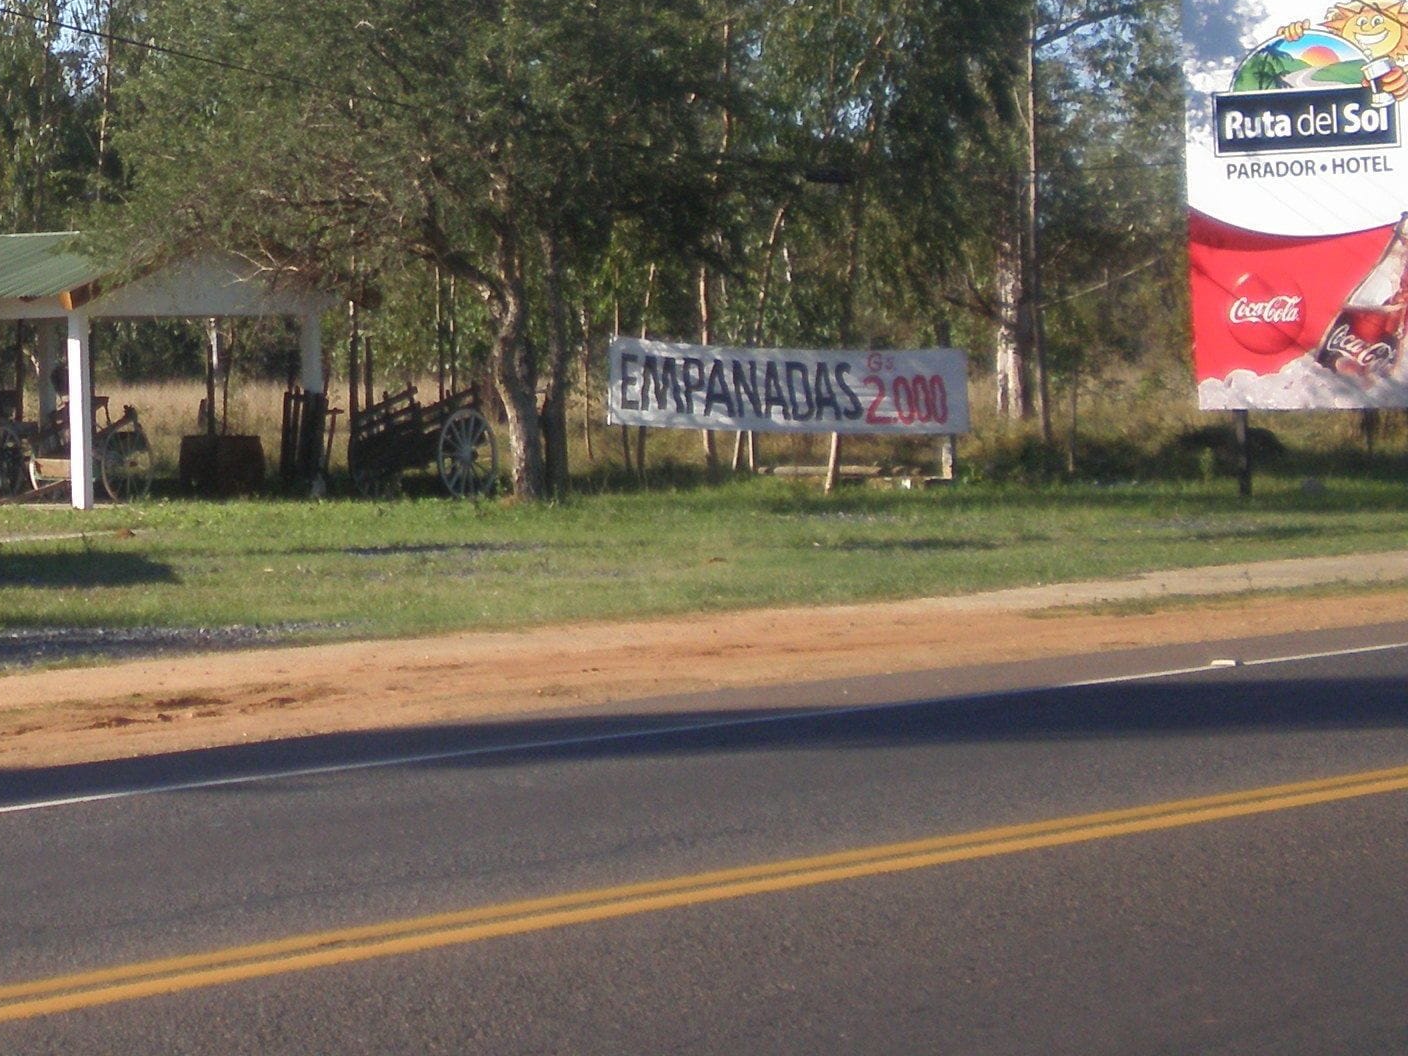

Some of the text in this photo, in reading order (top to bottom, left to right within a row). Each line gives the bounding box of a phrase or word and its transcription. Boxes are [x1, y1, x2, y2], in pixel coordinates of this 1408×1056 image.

[1225, 102, 1389, 140] Ruta del Sol
[1226, 155, 1393, 180] PARADOR HOTEL
[621, 352, 949, 425] EMPANADAS 2.000
